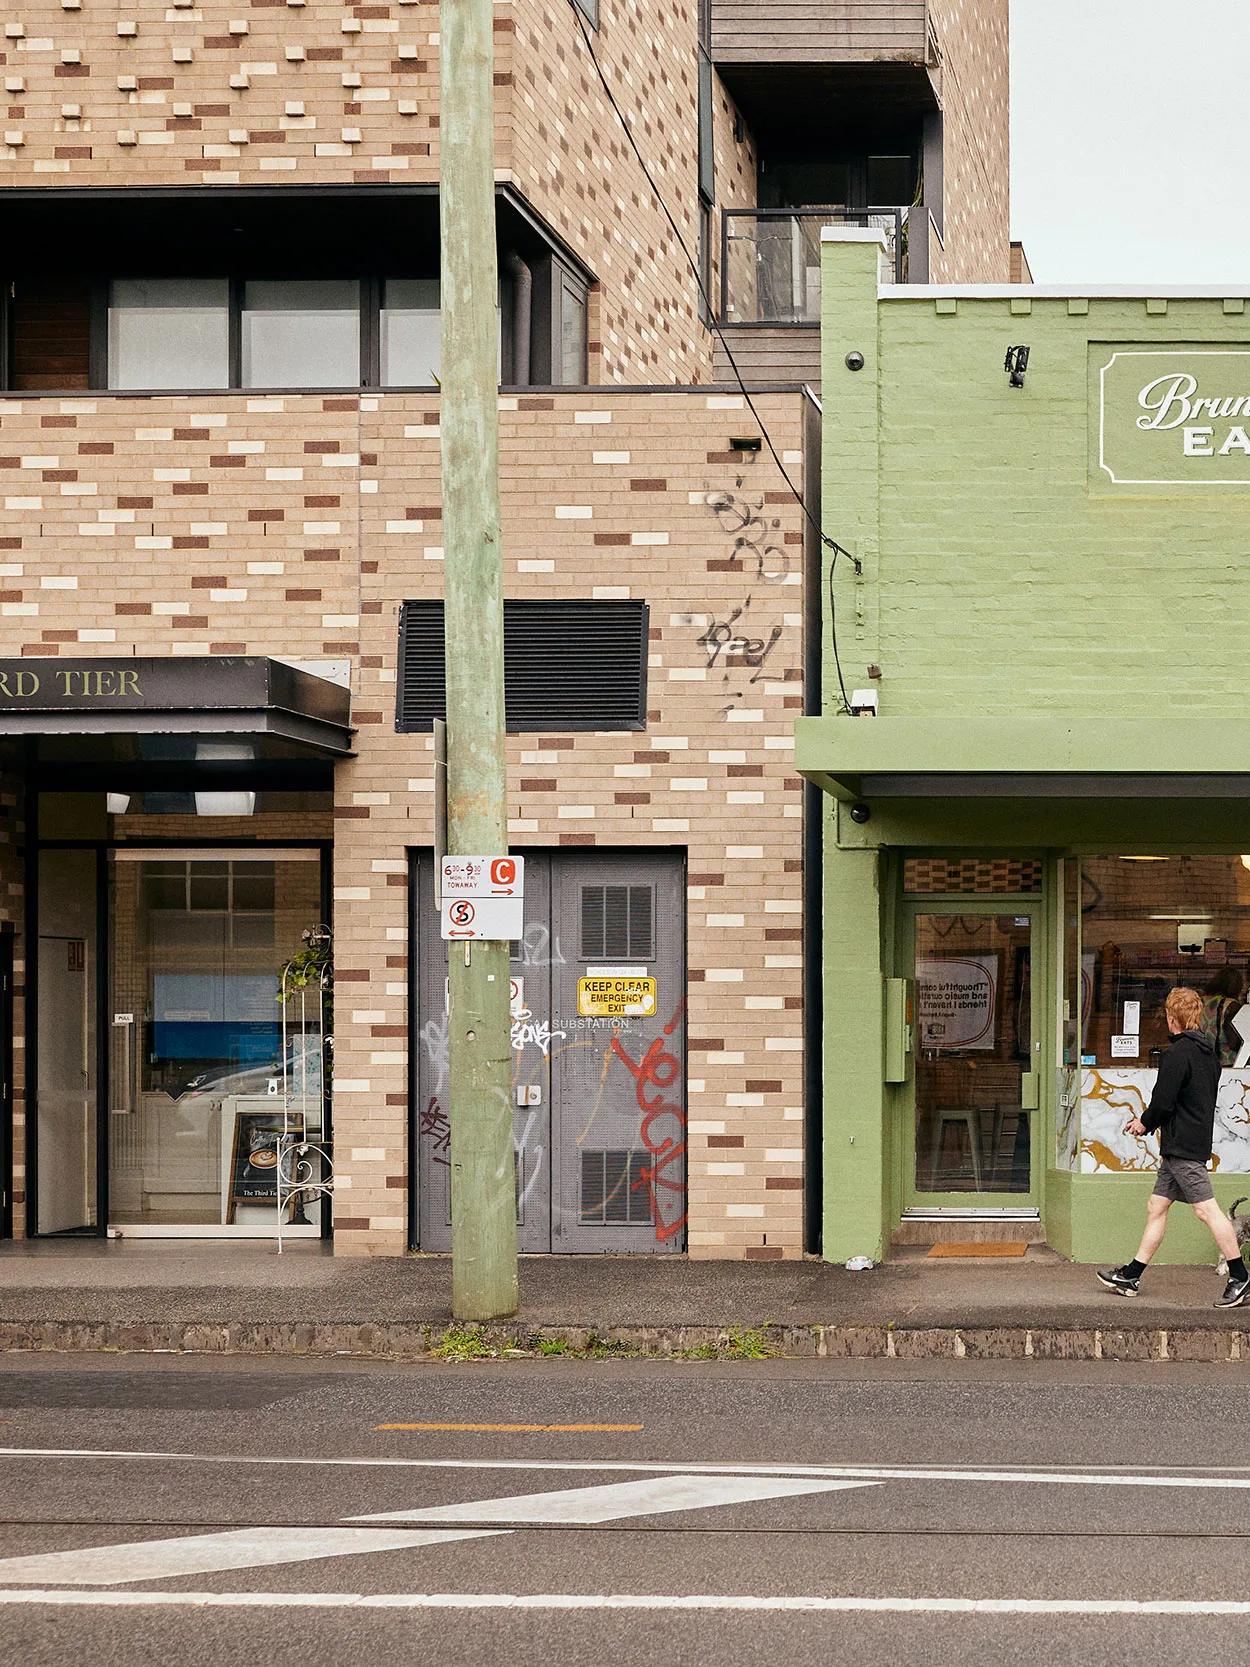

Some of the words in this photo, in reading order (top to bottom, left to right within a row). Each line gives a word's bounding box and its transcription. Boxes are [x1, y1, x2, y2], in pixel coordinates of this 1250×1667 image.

[55, 670, 144, 697] TIER
[584, 982, 612, 992] KEEP
[615, 982, 650, 992] CLEAR
[590, 994, 644, 1002] EMERGENCY
[608, 1004, 626, 1012] EXIT
[551, 1019, 629, 1029] SUBSTATION
